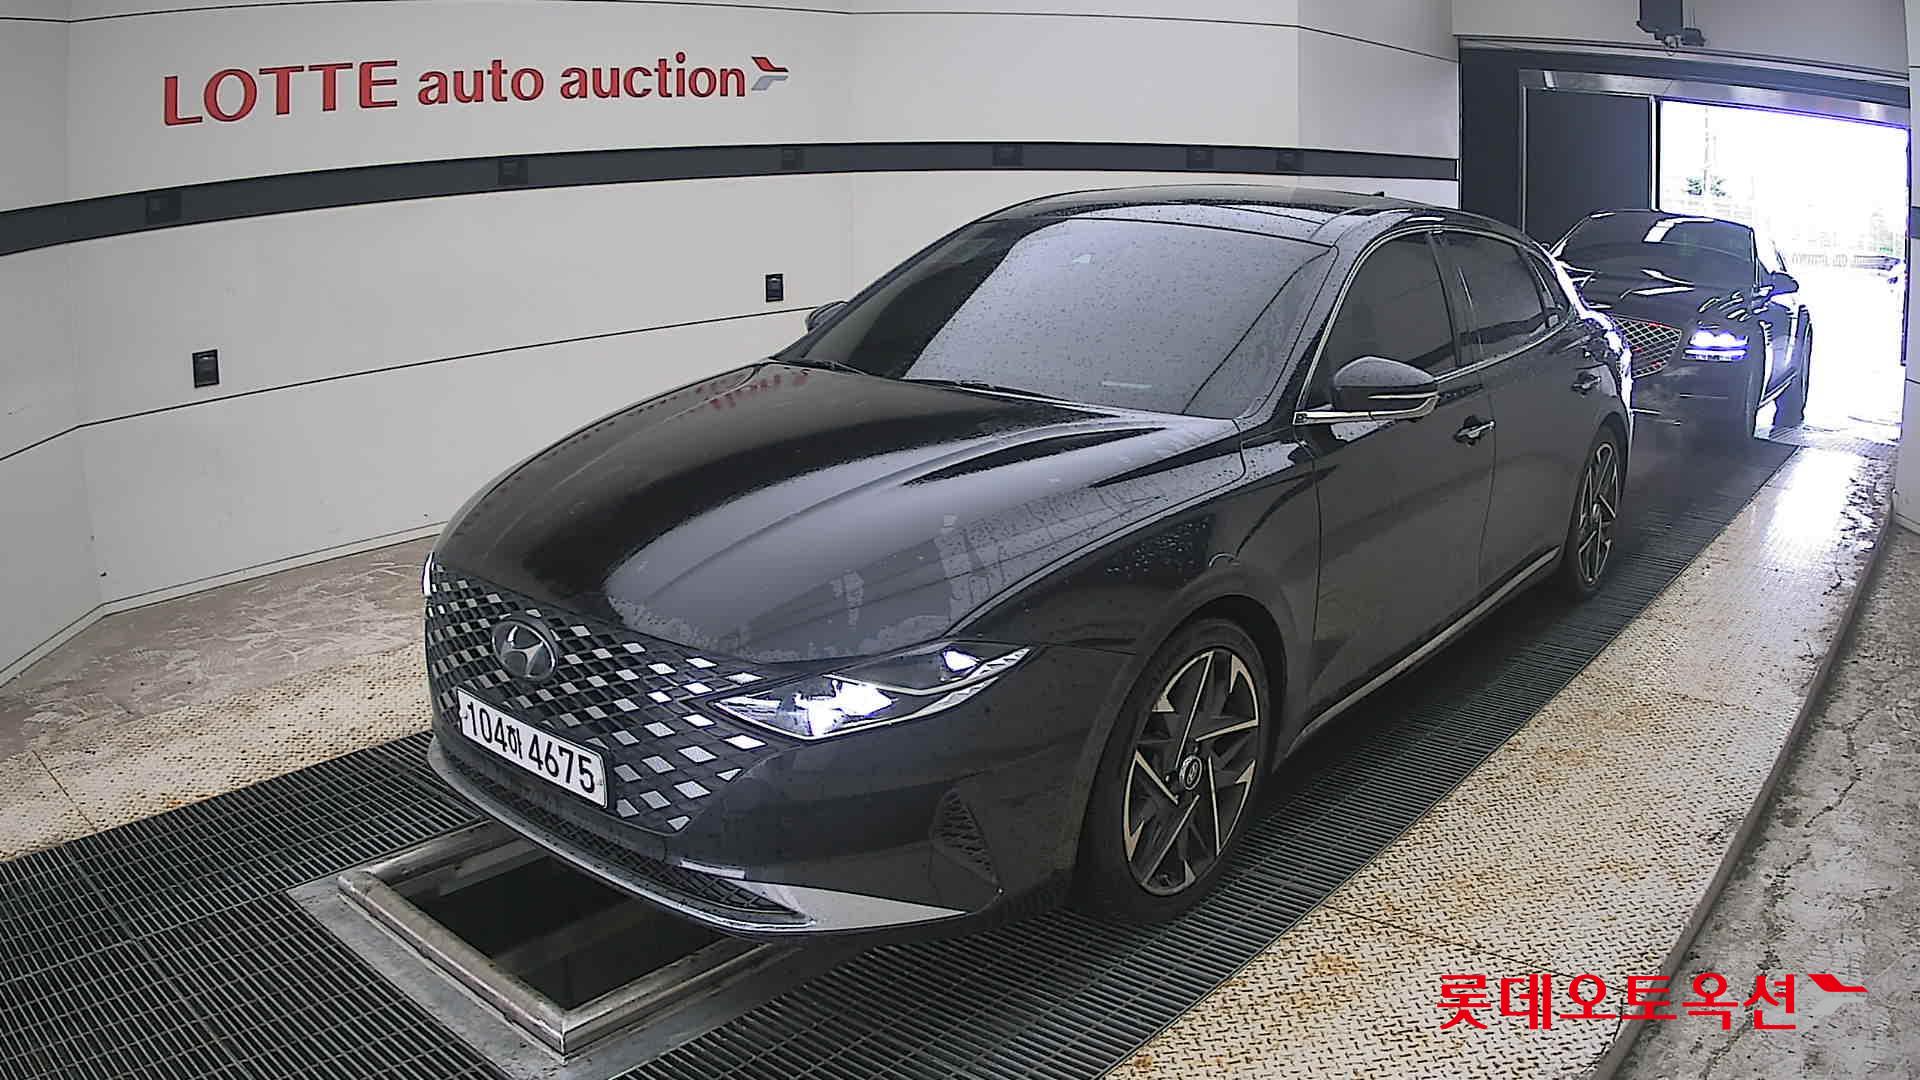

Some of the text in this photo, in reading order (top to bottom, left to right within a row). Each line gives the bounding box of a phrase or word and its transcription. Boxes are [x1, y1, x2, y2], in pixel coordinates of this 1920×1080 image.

[164, 52, 747, 126] LOTTE auto auction
[467, 702, 595, 793] 104하 4675
